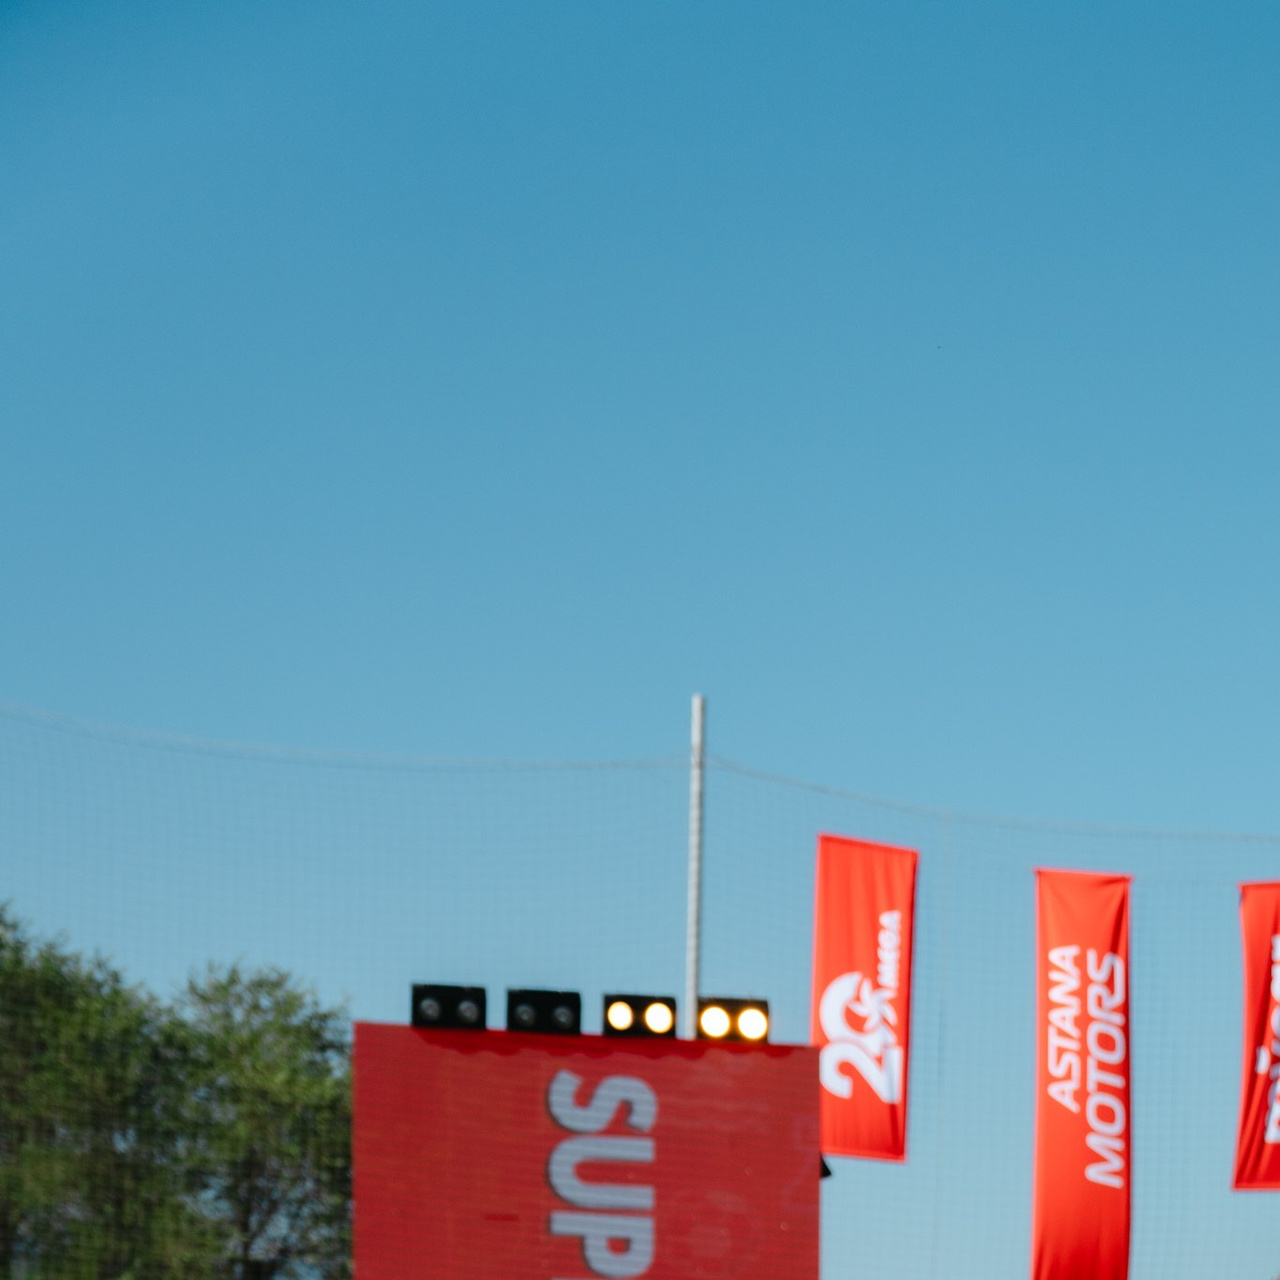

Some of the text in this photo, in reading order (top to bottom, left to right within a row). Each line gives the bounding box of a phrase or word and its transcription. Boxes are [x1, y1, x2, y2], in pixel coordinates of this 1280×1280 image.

[876, 909, 902, 989] MEGA
[1047, 944, 1081, 1114] ASTANA
[1084, 948, 1126, 1189] MOTORS
